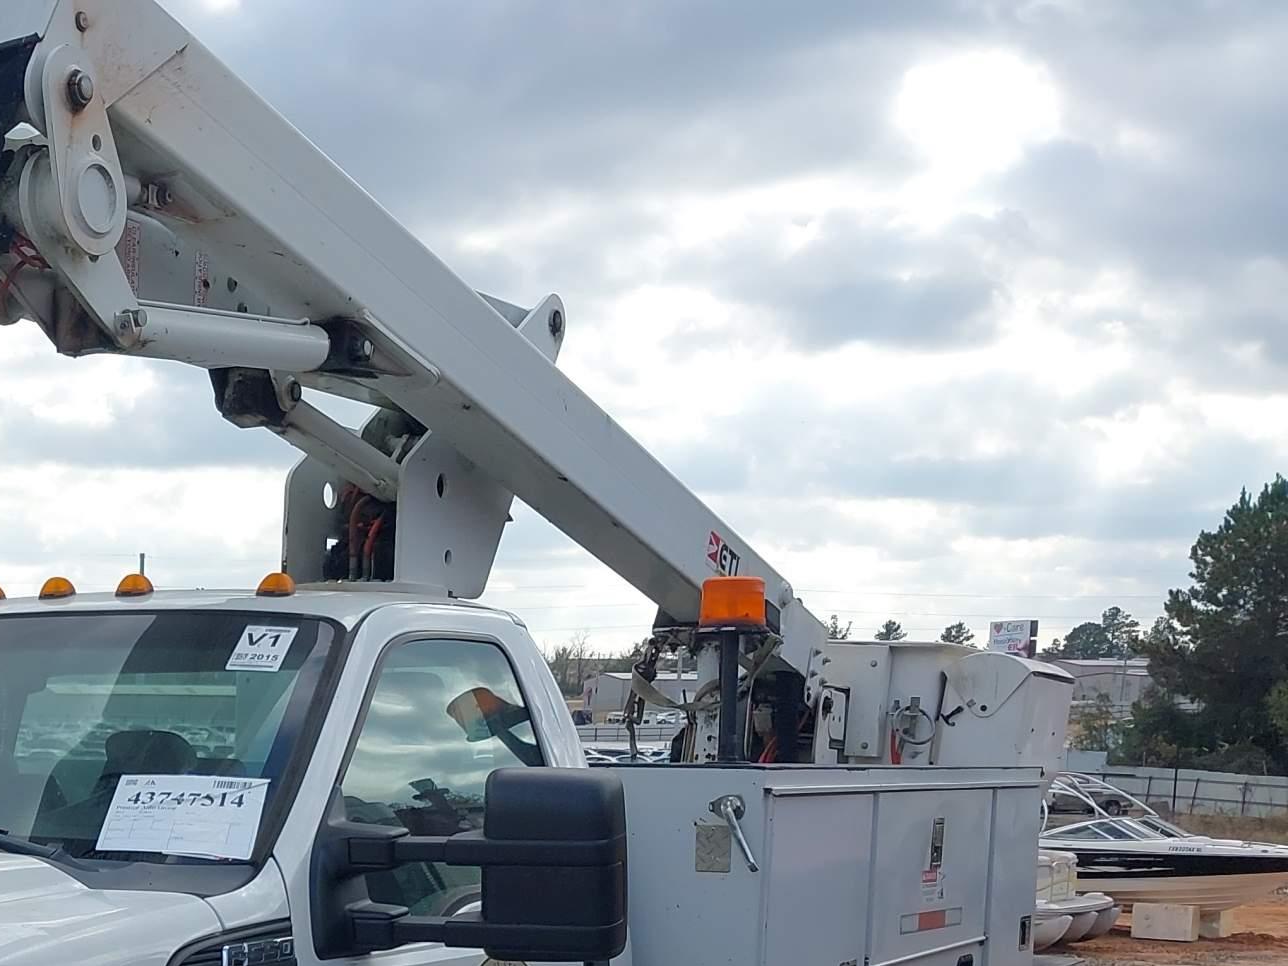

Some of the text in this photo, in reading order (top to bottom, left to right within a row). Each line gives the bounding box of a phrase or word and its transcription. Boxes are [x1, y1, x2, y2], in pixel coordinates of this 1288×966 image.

[720, 543, 741, 576] ETI
[247, 632, 282, 648] V1
[249, 653, 280, 662] 2015
